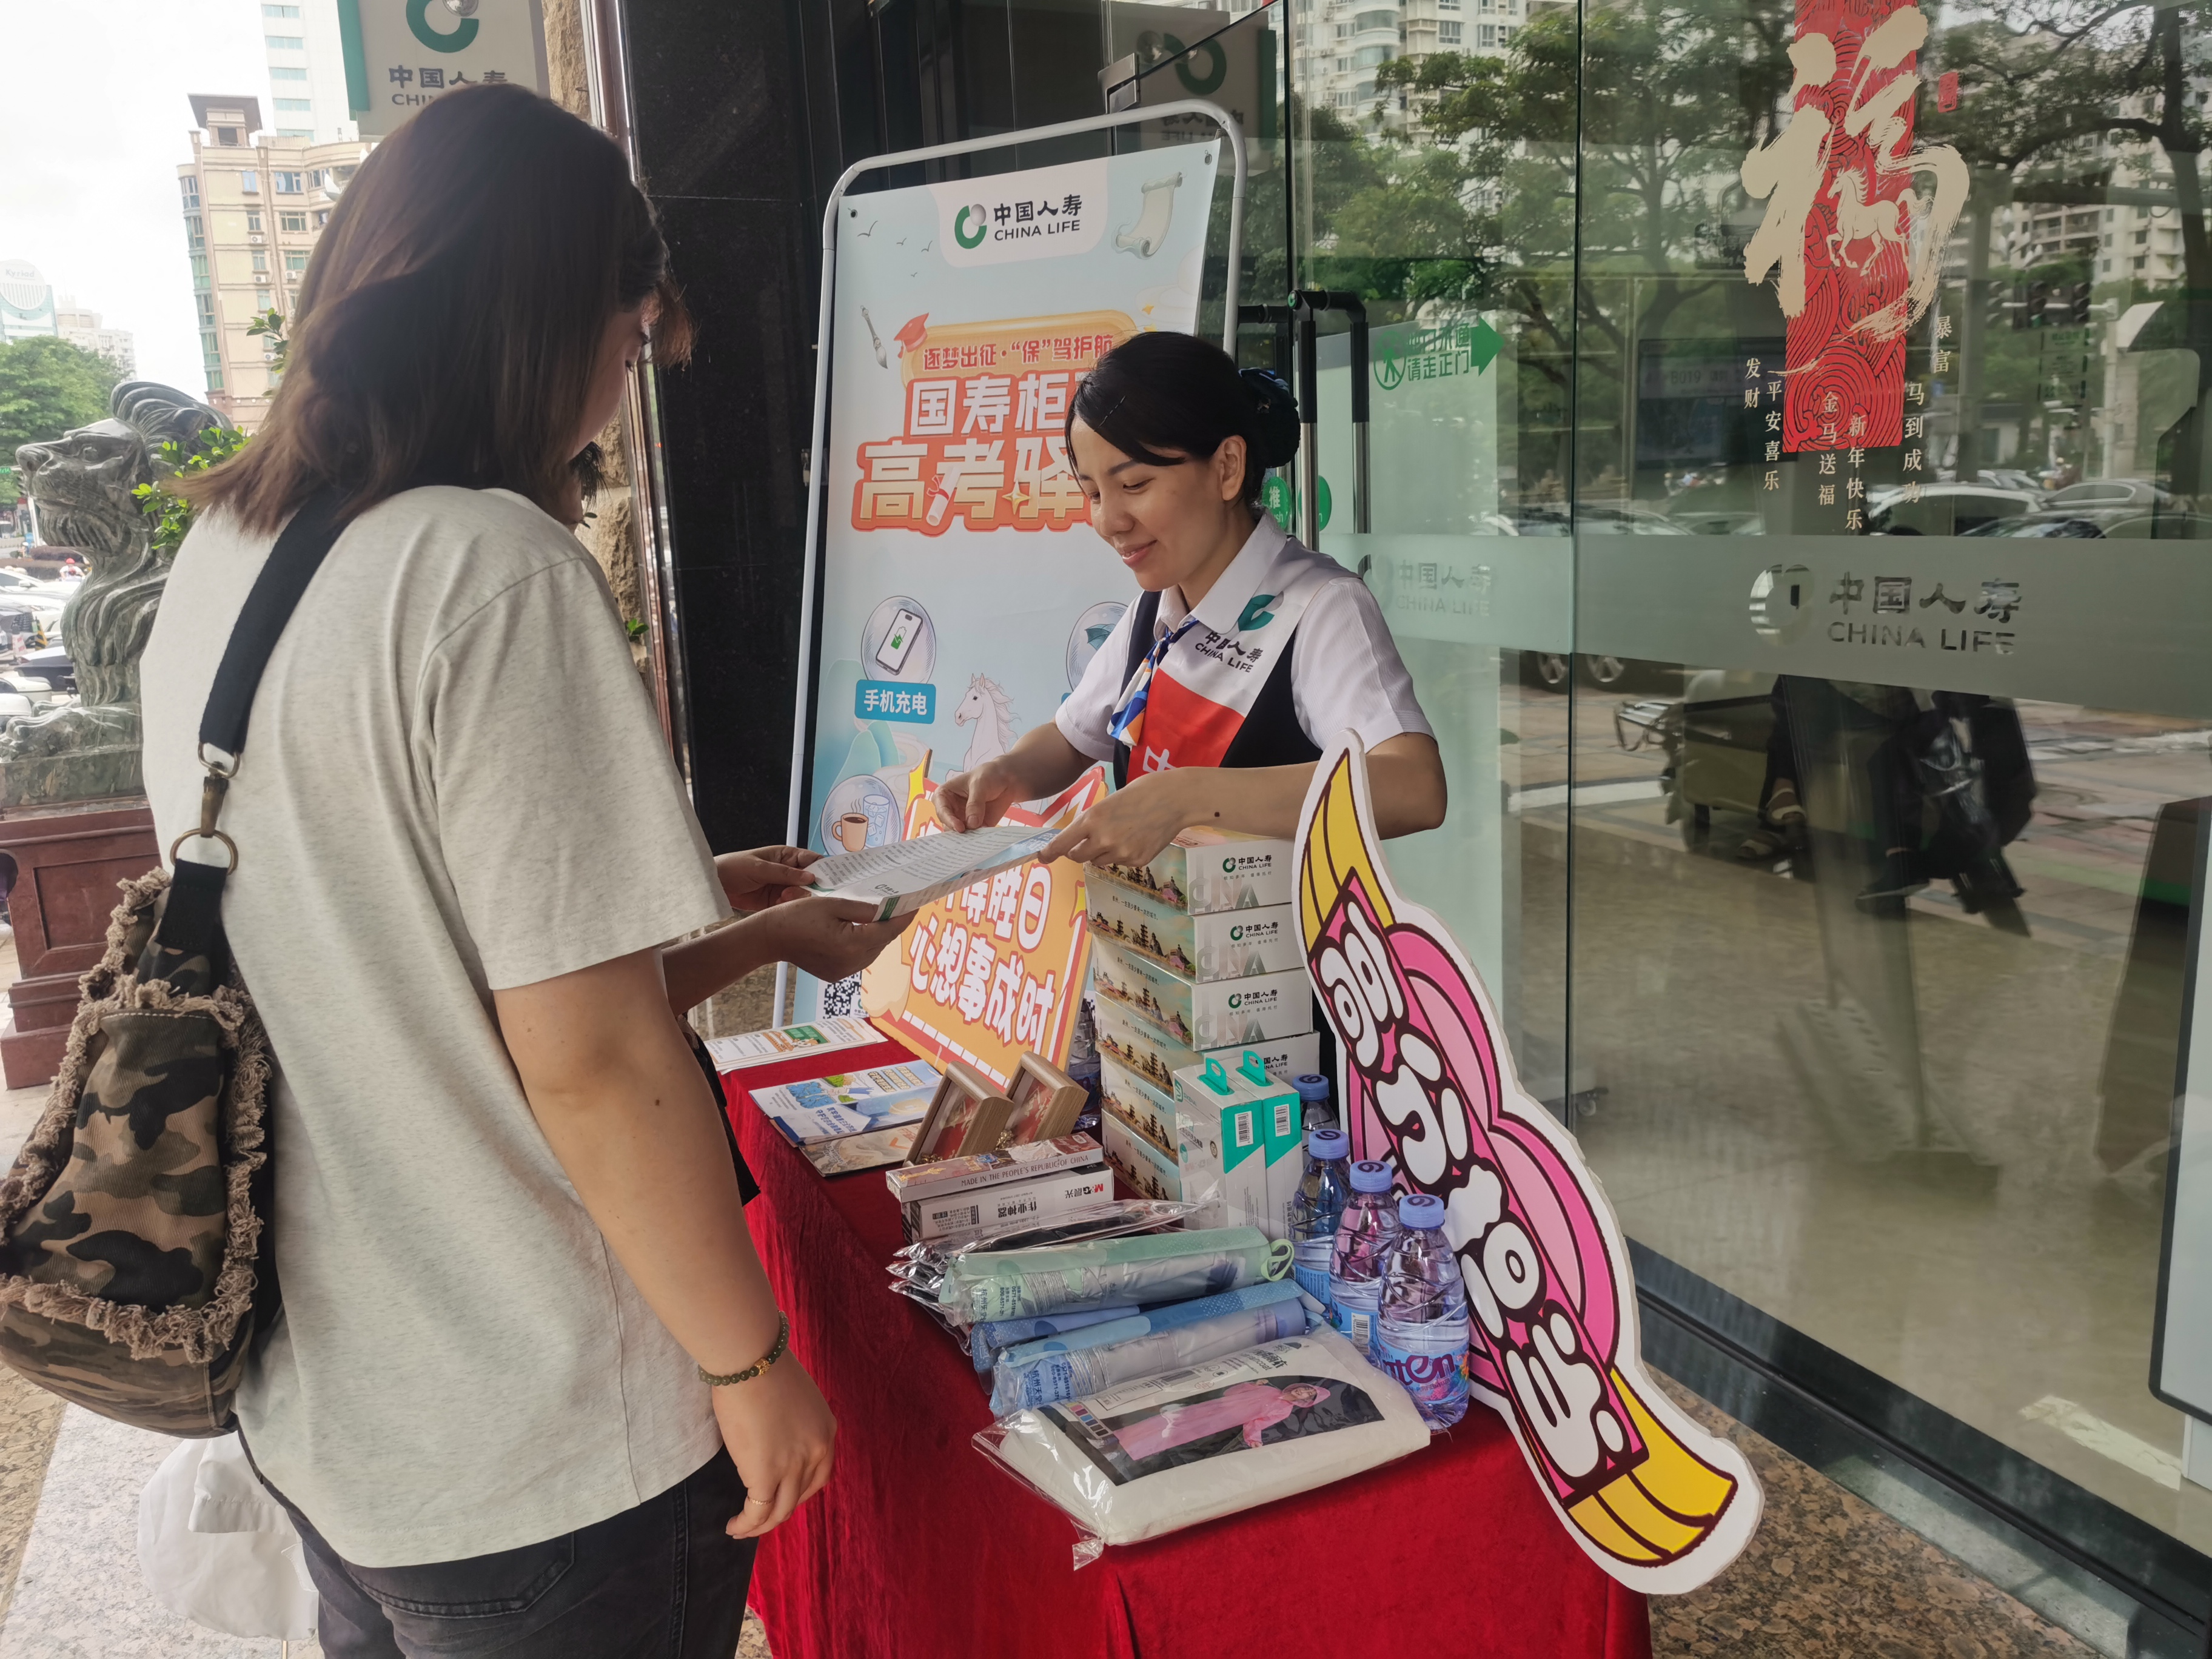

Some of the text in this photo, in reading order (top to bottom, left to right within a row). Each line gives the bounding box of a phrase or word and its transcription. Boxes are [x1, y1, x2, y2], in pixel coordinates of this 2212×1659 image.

[392, 93, 433, 106] CHI
[993, 193, 1082, 227] 中国人寿
[994, 219, 1081, 242] CHINA LIFE
[5, 269, 35, 278] Kyriad
[1932, 315, 1952, 375] 暴富
[1407, 349, 1470, 381] 请走正门
[1744, 357, 1761, 409] 发财
[910, 369, 1090, 436] 国寿柜
[1763, 380, 1782, 491] 平安喜乐
[1817, 391, 1839, 507] 金马送福
[1844, 415, 1867, 531] 新年快乐
[1829, 571, 2022, 623] 中国人寿
[1205, 631, 1264, 663] 中国人寿
[1827, 622, 2016, 655] CHINA LIFE
[1195, 643, 1254, 673] CHINA LIFE
[863, 688, 928, 716] 手机充电
[1238, 854, 1272, 865] 中国人寿
[1245, 922, 1279, 933] 中国人寿
[910, 916, 1055, 1055] 心想事成时
[1244, 989, 1278, 1000] 中国人寿
[961, 1178, 978, 1187] MADE
[1002, 1167, 1029, 1178] PEOPLE'S
[1031, 1162, 1057, 1172] REPUBLIC
[1070, 1155, 1089, 1164] CHINA
[997, 1201, 1037, 1218] 作业神器
